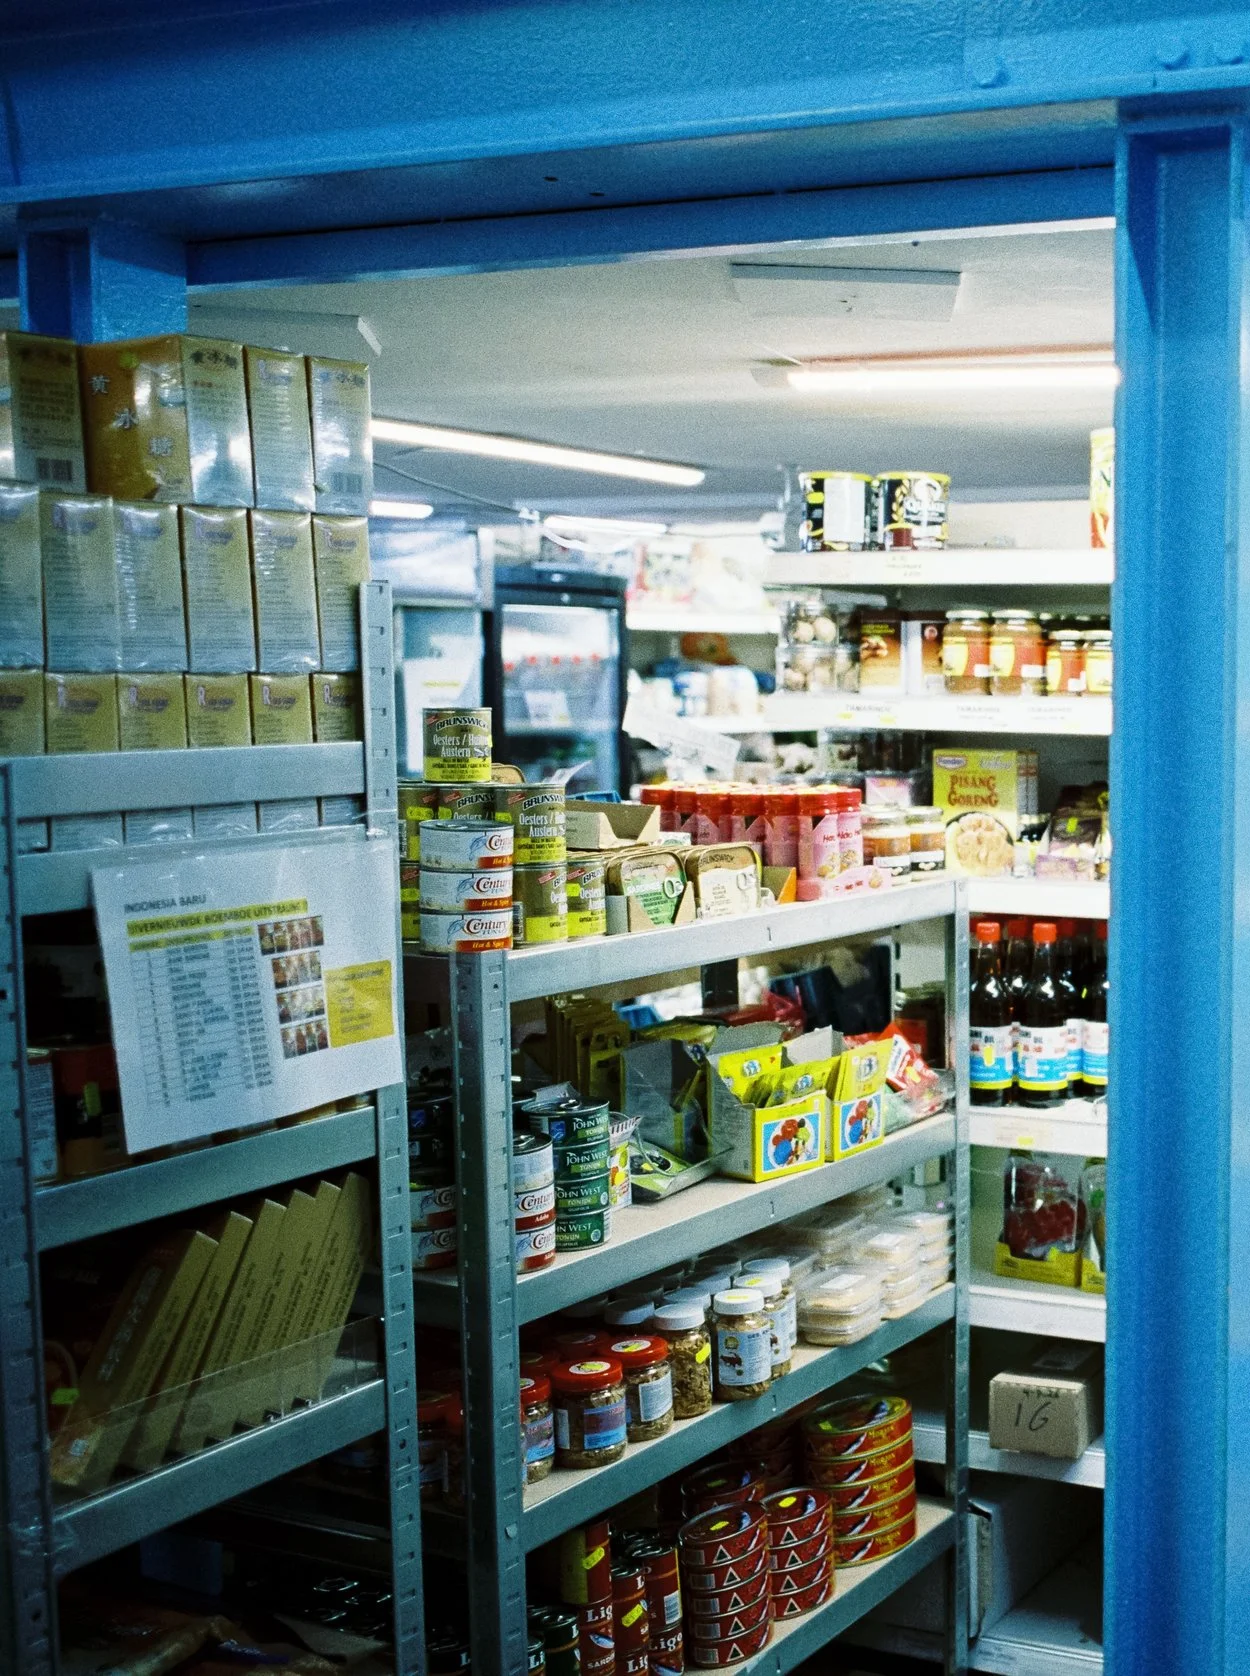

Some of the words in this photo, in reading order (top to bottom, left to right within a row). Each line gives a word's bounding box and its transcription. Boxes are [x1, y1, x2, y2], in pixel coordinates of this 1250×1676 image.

[951, 774, 997, 791] PISANG
[948, 791, 999, 807] GORENG
[124, 896, 178, 914] INDONESIA
[179, 893, 207, 909] BARU
[466, 918, 506, 934] Century
[573, 1118, 596, 1130] JOHN
[566, 1152, 590, 1166] JOHN
[580, 1186, 600, 1197] WEST
[569, 1222, 592, 1232] WEST
